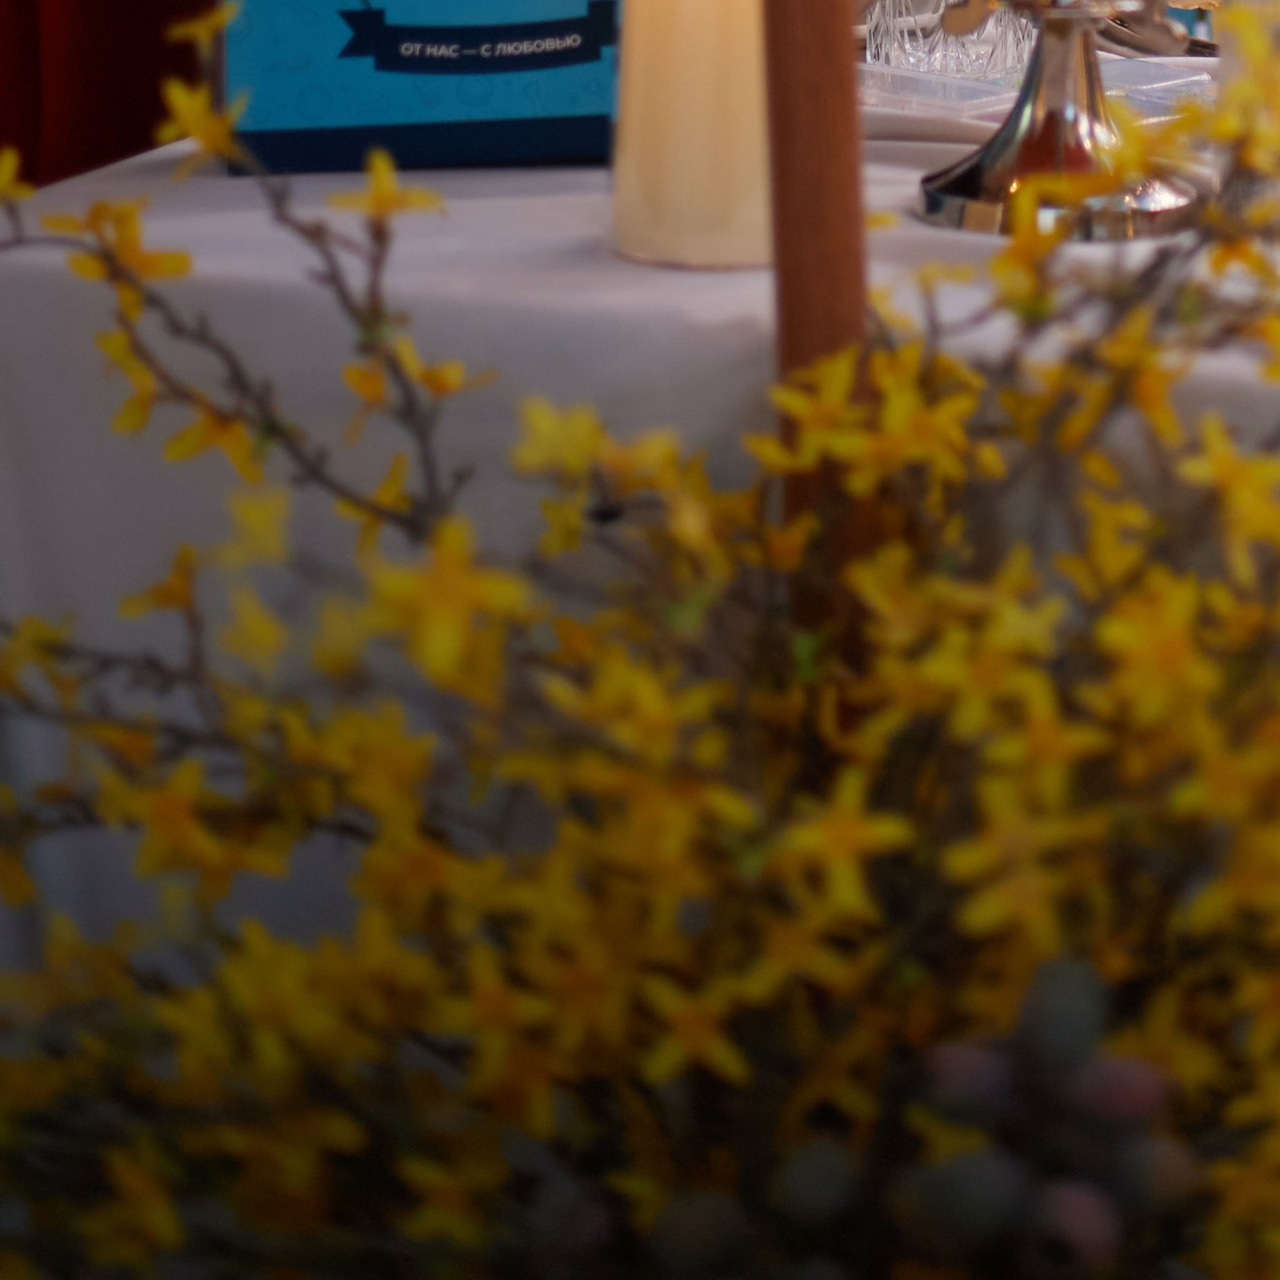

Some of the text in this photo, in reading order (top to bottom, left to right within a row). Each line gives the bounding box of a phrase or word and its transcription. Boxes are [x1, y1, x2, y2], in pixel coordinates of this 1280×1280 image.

[400, 42, 422, 57] ОТ
[426, 43, 460, 58] НАС
[479, 43, 492, 58] С
[494, 34, 582, 57] ЛЮБОВЬЮ
